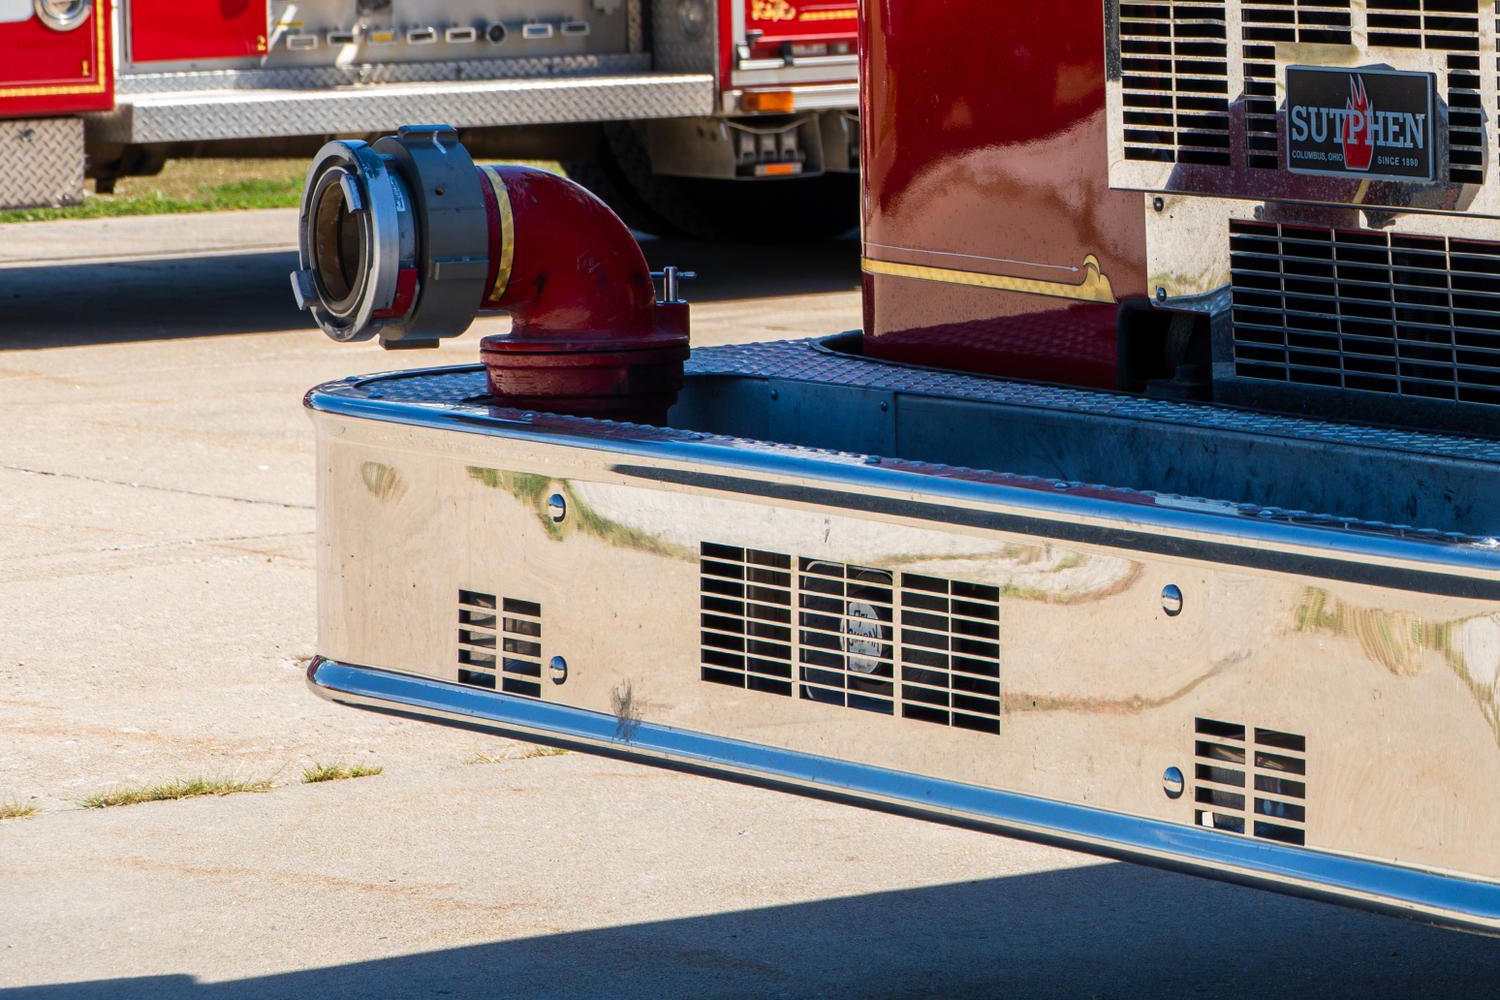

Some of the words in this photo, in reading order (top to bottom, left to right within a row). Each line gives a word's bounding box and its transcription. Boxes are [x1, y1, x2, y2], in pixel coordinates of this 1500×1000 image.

[1291, 104, 1426, 149] SUTPHEN
[1291, 149, 1328, 161] COLUMBUS,
[1328, 152, 1343, 162] OHIO
[1377, 155, 1400, 166] SINCE
